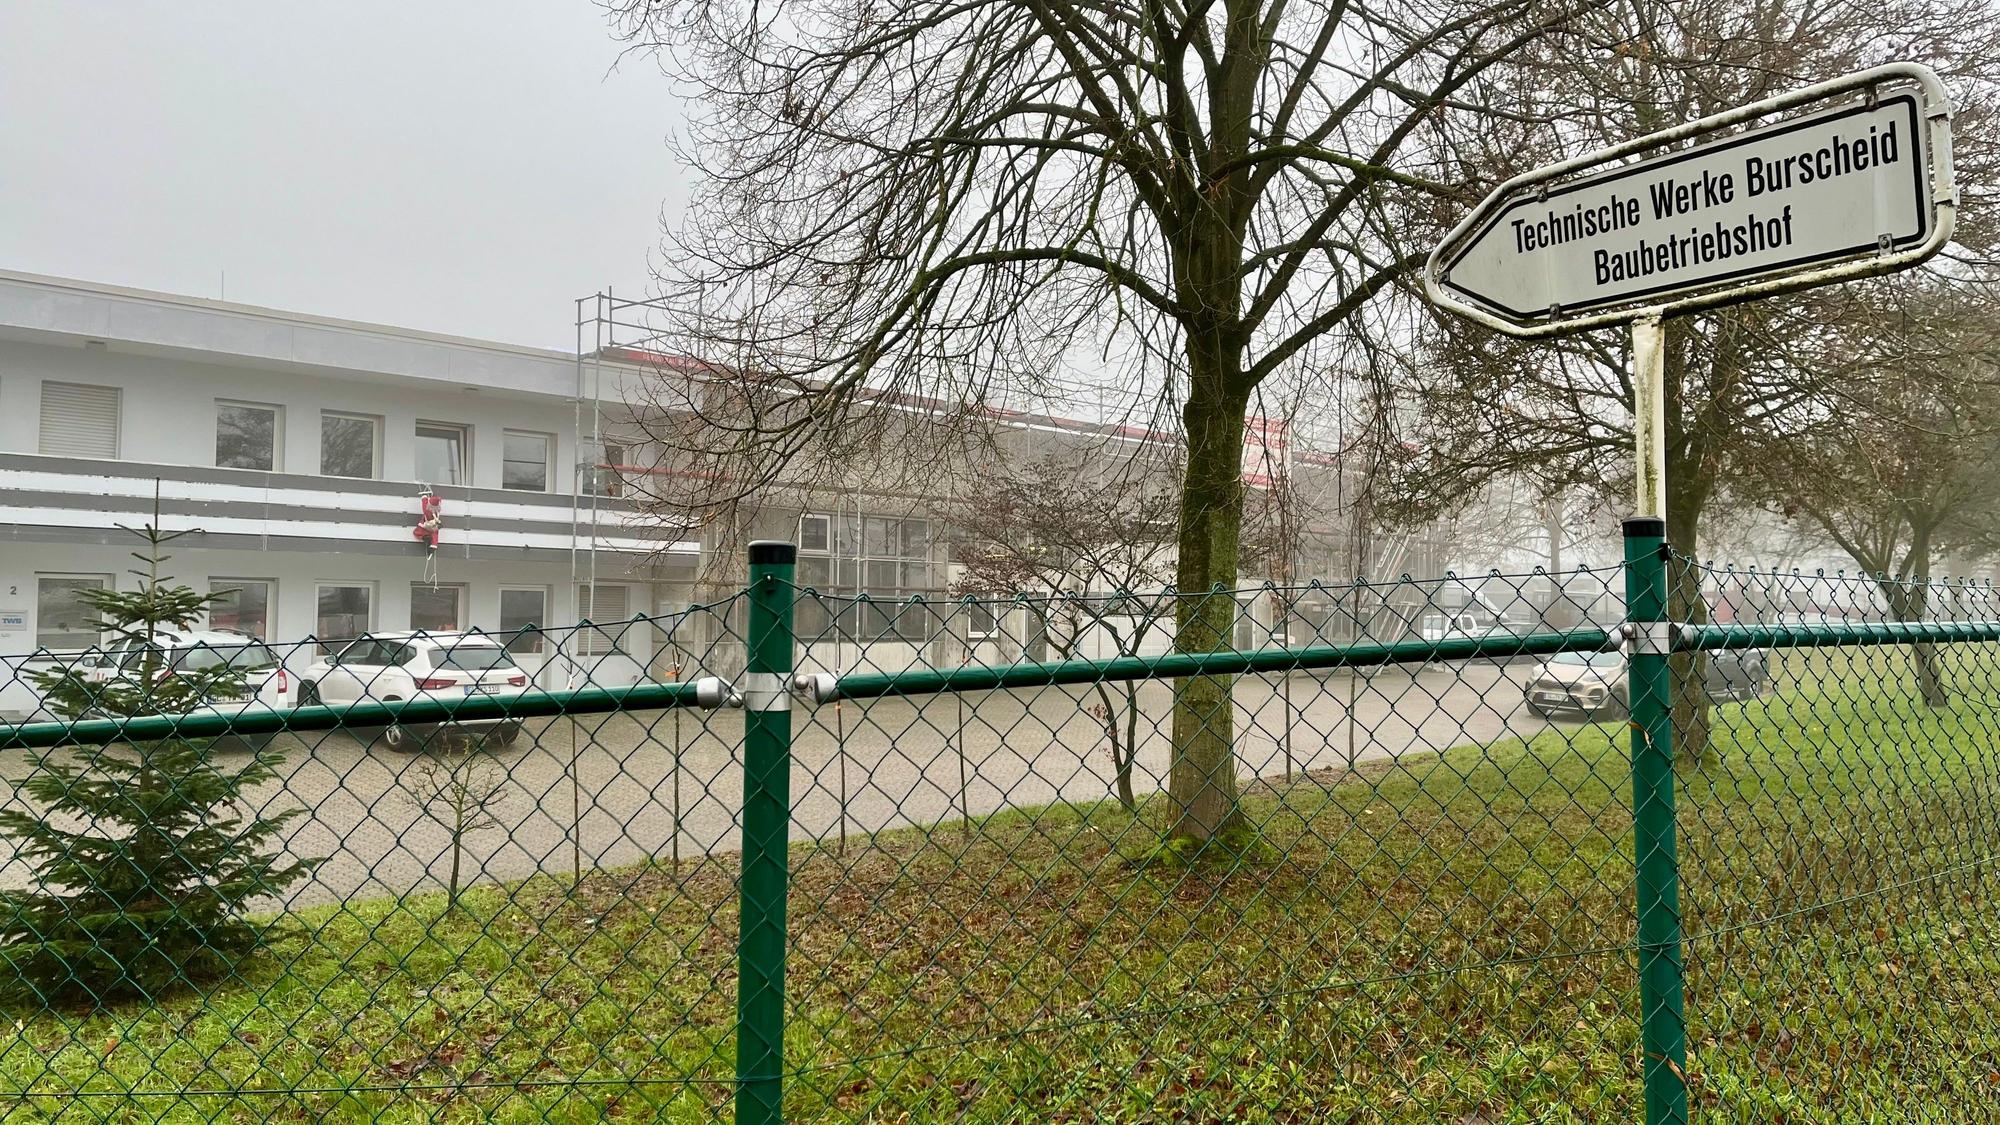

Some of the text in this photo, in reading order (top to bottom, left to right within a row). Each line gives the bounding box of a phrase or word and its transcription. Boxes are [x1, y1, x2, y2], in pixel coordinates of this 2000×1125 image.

[1511, 120, 1899, 254] Technische Werke Burscheid
[1593, 204, 1793, 286] Baubetriebshof
[10, 586, 17, 595] 2
